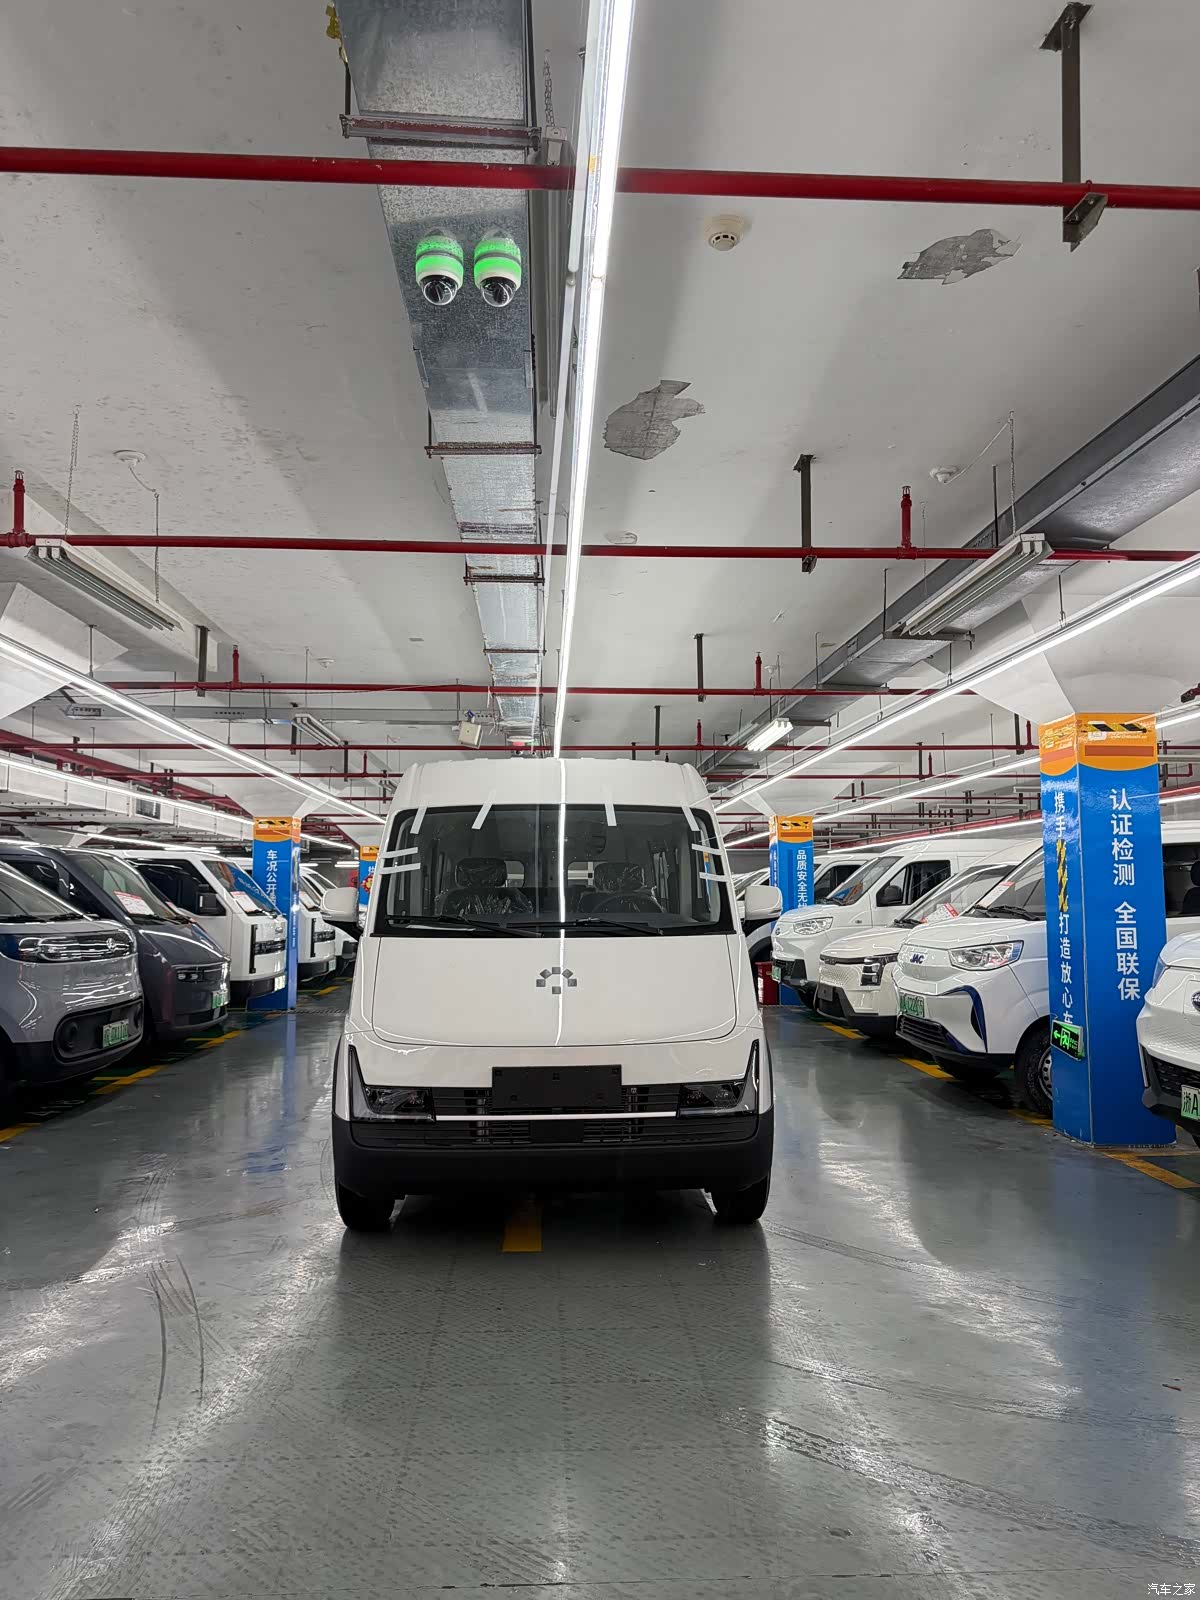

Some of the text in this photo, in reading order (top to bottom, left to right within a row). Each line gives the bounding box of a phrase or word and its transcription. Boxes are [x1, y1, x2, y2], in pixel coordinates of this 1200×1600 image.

[1109, 788, 1141, 1001] 认证检测 全国联保
